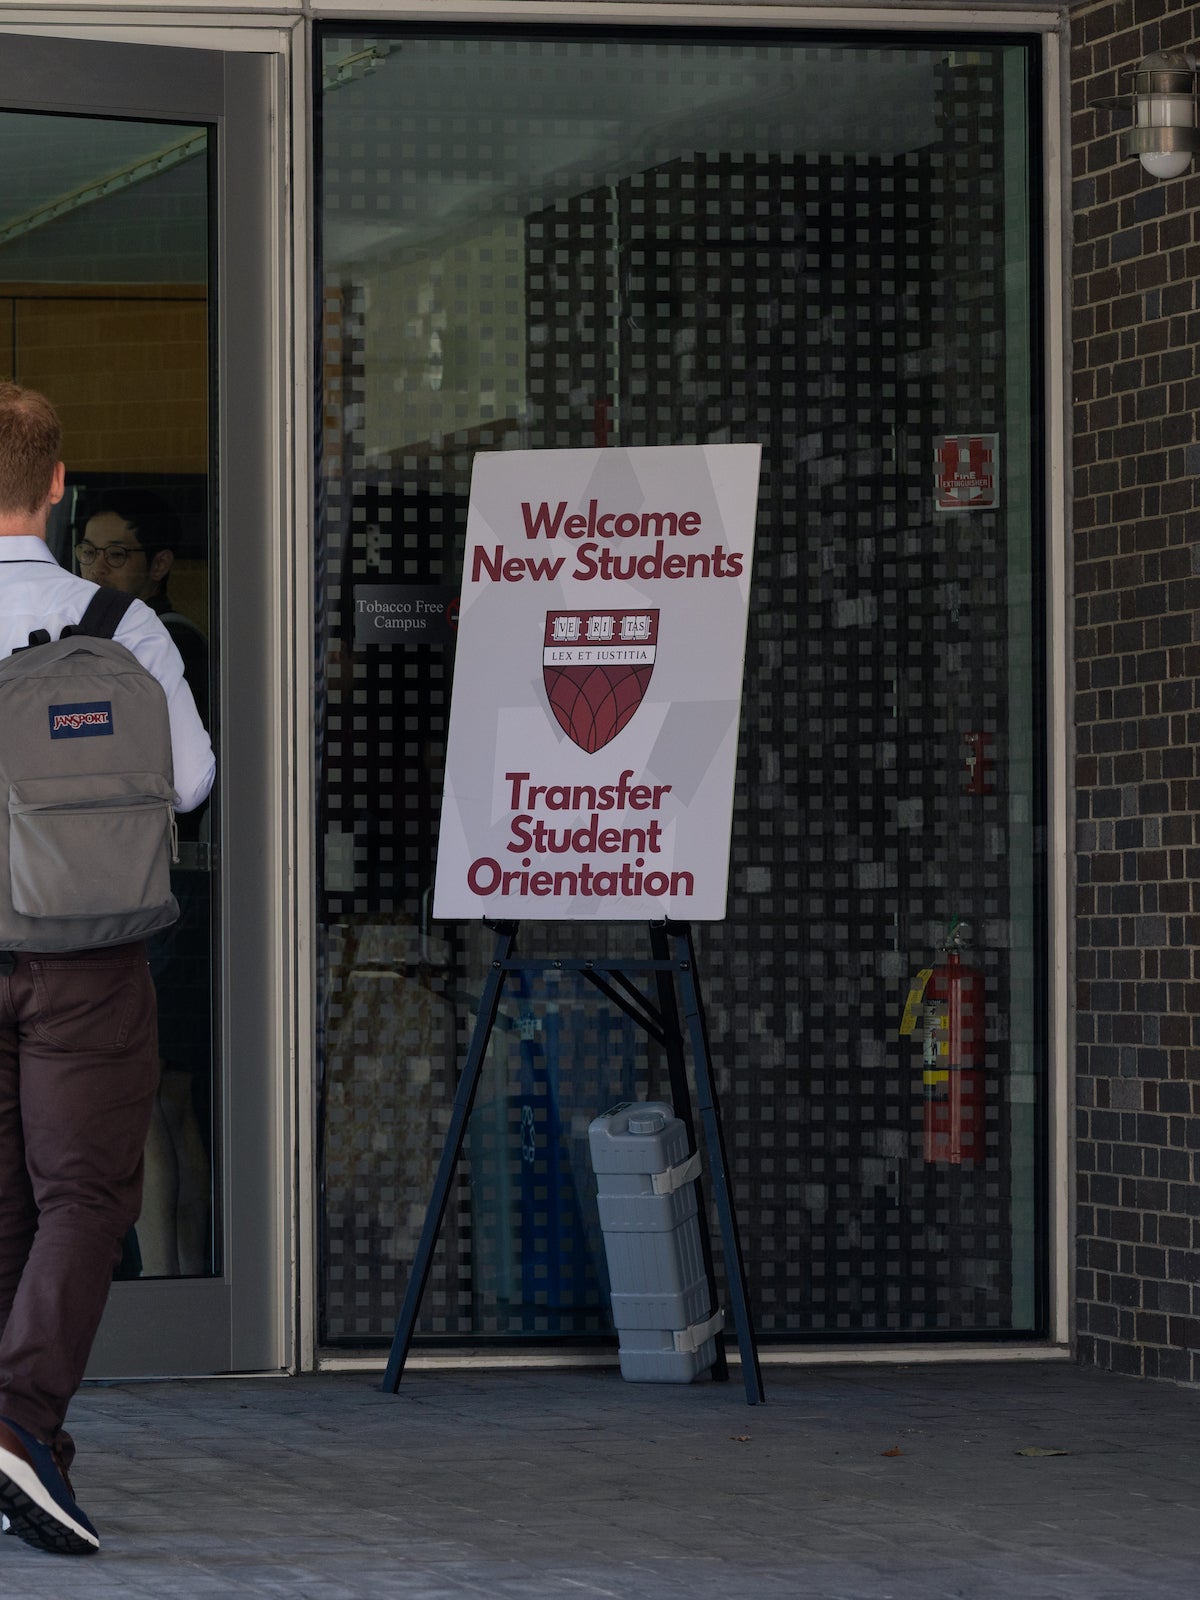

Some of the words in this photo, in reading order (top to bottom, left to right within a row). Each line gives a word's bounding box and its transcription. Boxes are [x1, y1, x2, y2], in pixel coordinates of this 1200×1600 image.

[521, 499, 701, 539] Welcome
[472, 545, 566, 582] New
[572, 540, 744, 580] Students
[357, 600, 412, 613] Tobacco
[416, 600, 444, 613] Free
[374, 616, 427, 631] Campus
[552, 651, 573, 661] LEX
[578, 651, 592, 660] ET
[597, 650, 648, 660] IUSTITIA
[53, 711, 109, 731] JANSPORT
[505, 770, 672, 810] Transfer
[506, 814, 662, 853] Student
[467, 857, 694, 896] Orientation
